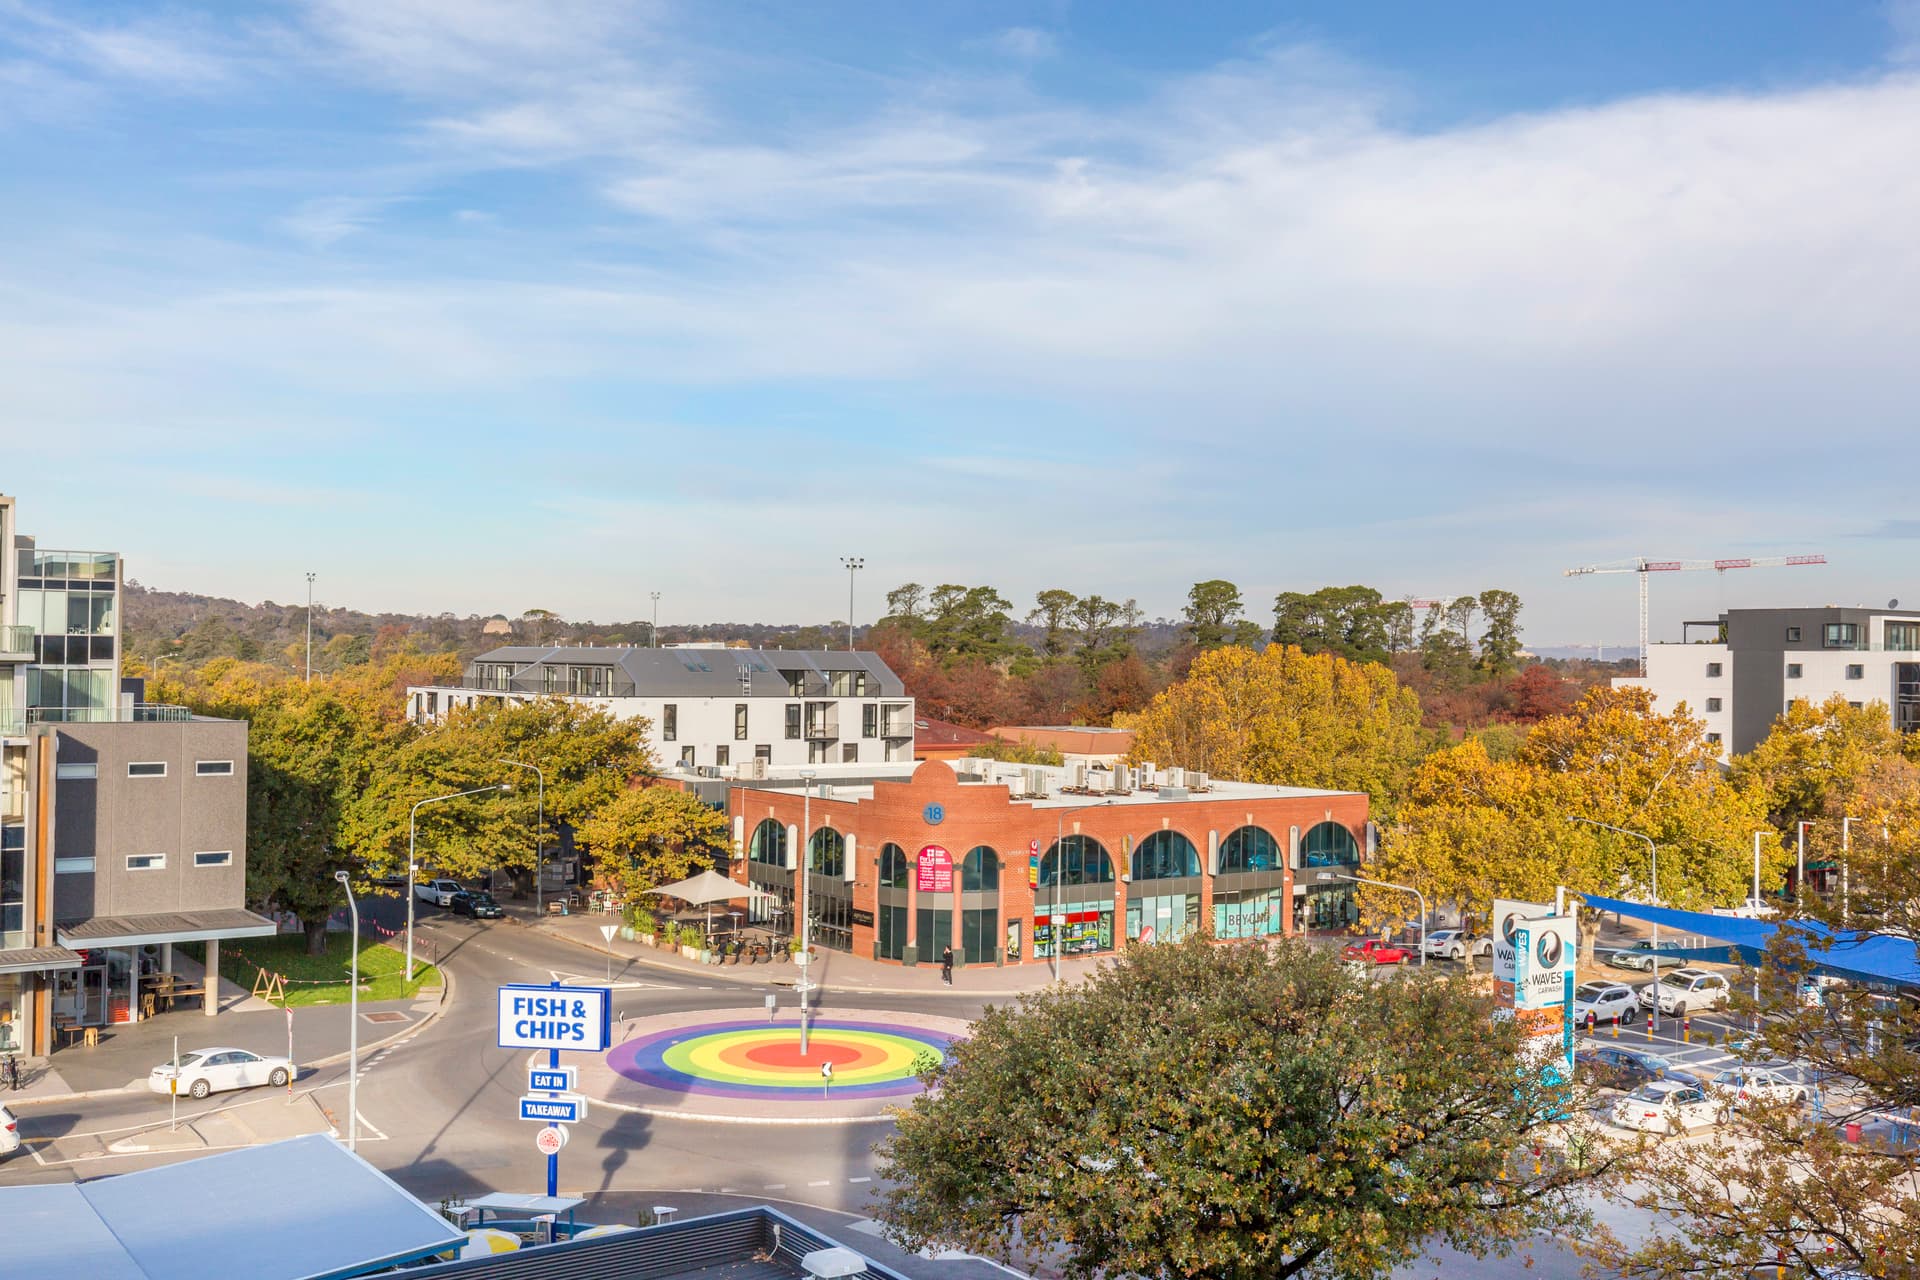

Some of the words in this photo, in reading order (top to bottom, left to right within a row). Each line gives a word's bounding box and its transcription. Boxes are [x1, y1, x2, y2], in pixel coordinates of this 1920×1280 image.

[927, 807, 942, 820] 18
[1518, 932, 1527, 967] WAVES
[1532, 971, 1562, 986] WAVES
[1538, 986, 1562, 994] CARWASH
[513, 997, 566, 1017] FISH
[572, 1000, 587, 1018] &
[515, 1020, 585, 1041] CHIPS
[534, 1075, 552, 1087] EAT
[553, 1076, 563, 1087] IN
[525, 1103, 572, 1118] TAKEAWAY
